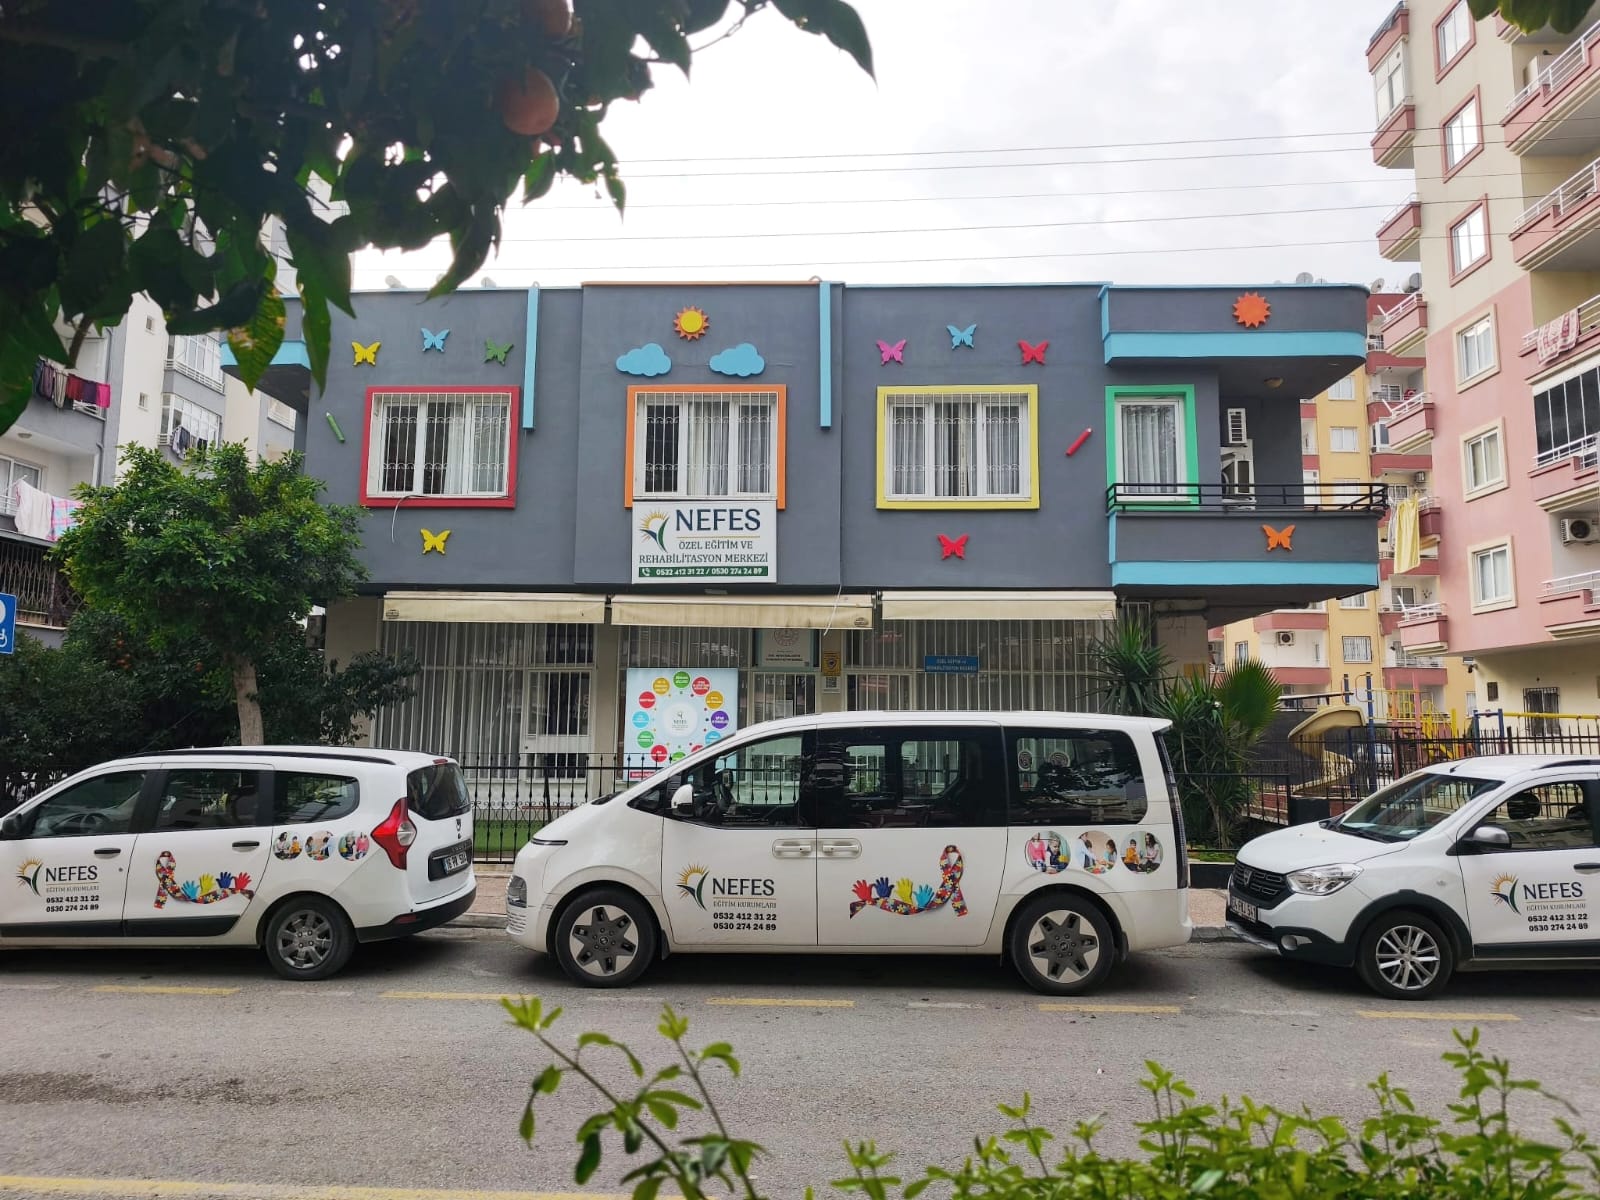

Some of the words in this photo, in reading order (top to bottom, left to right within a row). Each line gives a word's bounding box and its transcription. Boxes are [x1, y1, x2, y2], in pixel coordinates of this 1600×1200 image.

[676, 508, 760, 532] NEFES
[678, 540, 702, 550] ÖZEL
[705, 539, 738, 550] EĞİTİM
[741, 540, 753, 549] VE
[639, 552, 722, 564] REHABİLİTASYON
[725, 552, 768, 563] MERKEZİ
[46, 865, 98, 882] NEFES
[712, 878, 774, 896] NEFES
[1523, 882, 1583, 900] NEFES
